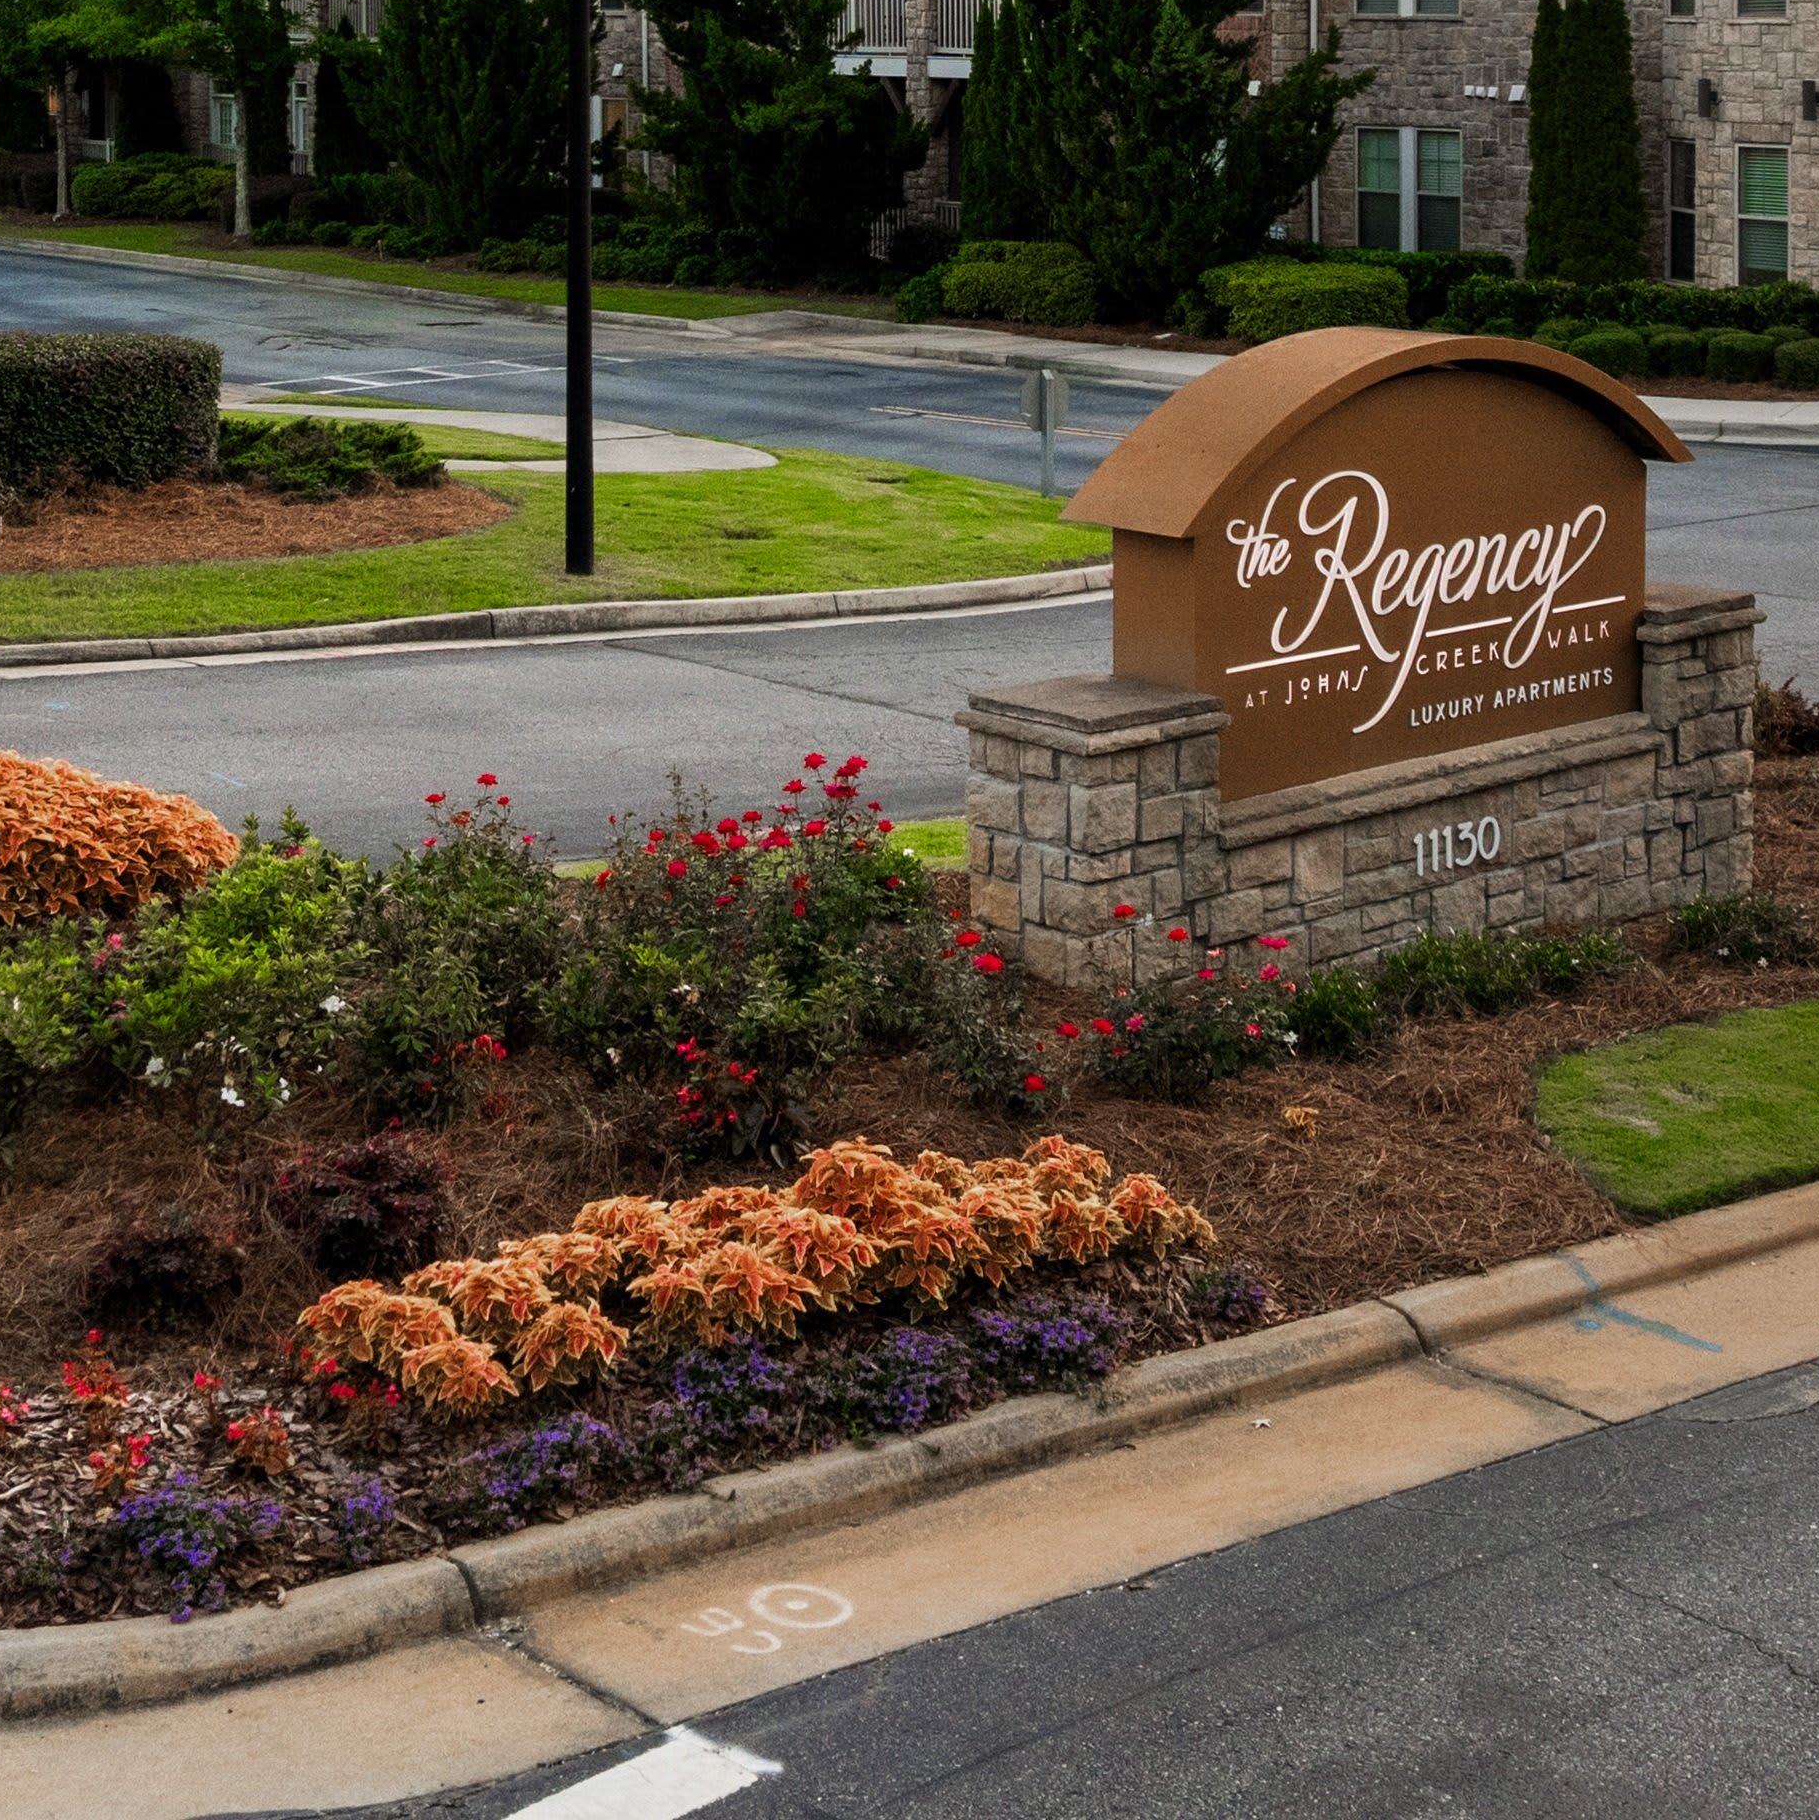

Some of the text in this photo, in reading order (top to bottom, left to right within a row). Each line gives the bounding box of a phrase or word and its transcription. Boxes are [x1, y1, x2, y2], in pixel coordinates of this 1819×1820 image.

[1226, 469, 1607, 734] the Regency
[1245, 620, 1610, 709] AT JOHNS CREEK WALK
[1410, 667, 1614, 727] LUXURY APARTMENTS
[1413, 816, 1501, 877] 11130
